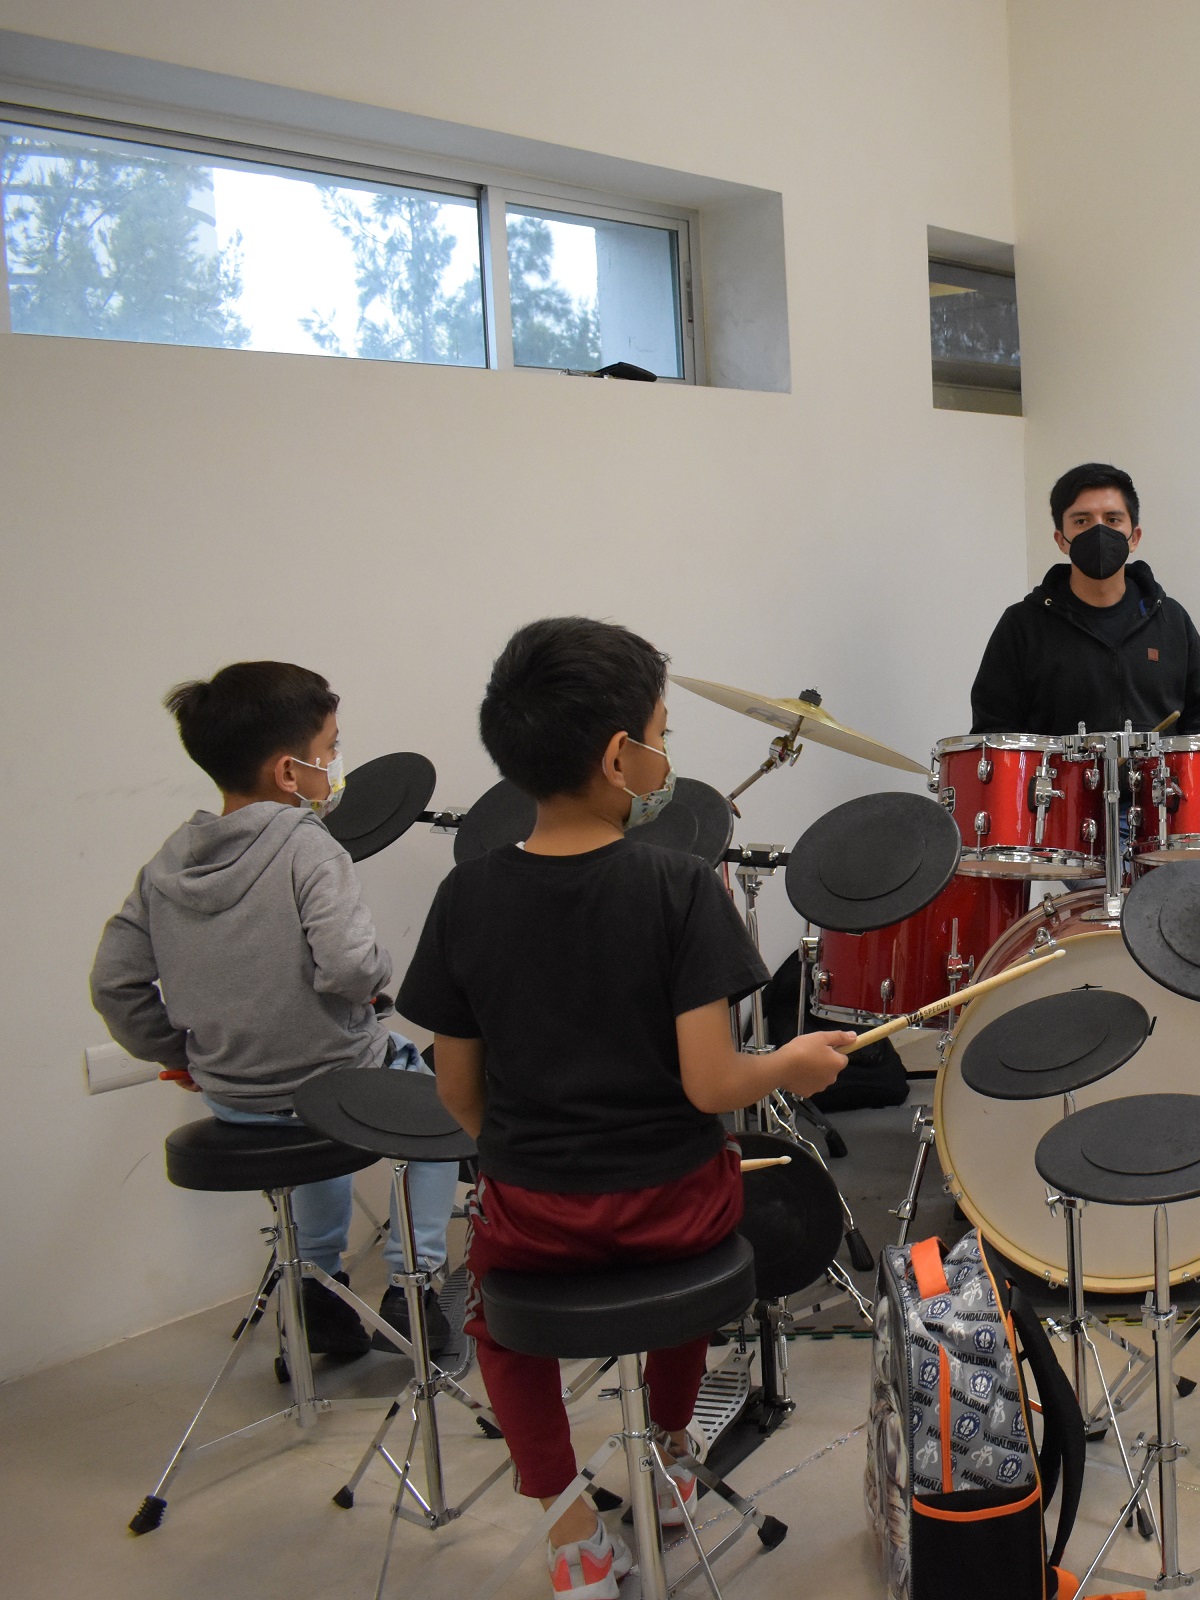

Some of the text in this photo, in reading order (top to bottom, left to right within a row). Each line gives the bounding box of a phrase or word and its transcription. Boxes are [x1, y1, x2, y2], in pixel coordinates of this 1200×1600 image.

[923, 1001, 951, 1015] SPECIAL
[953, 1312, 1002, 1323] MANDALORIAN
[983, 1431, 1029, 1454] MANDALORIAN
